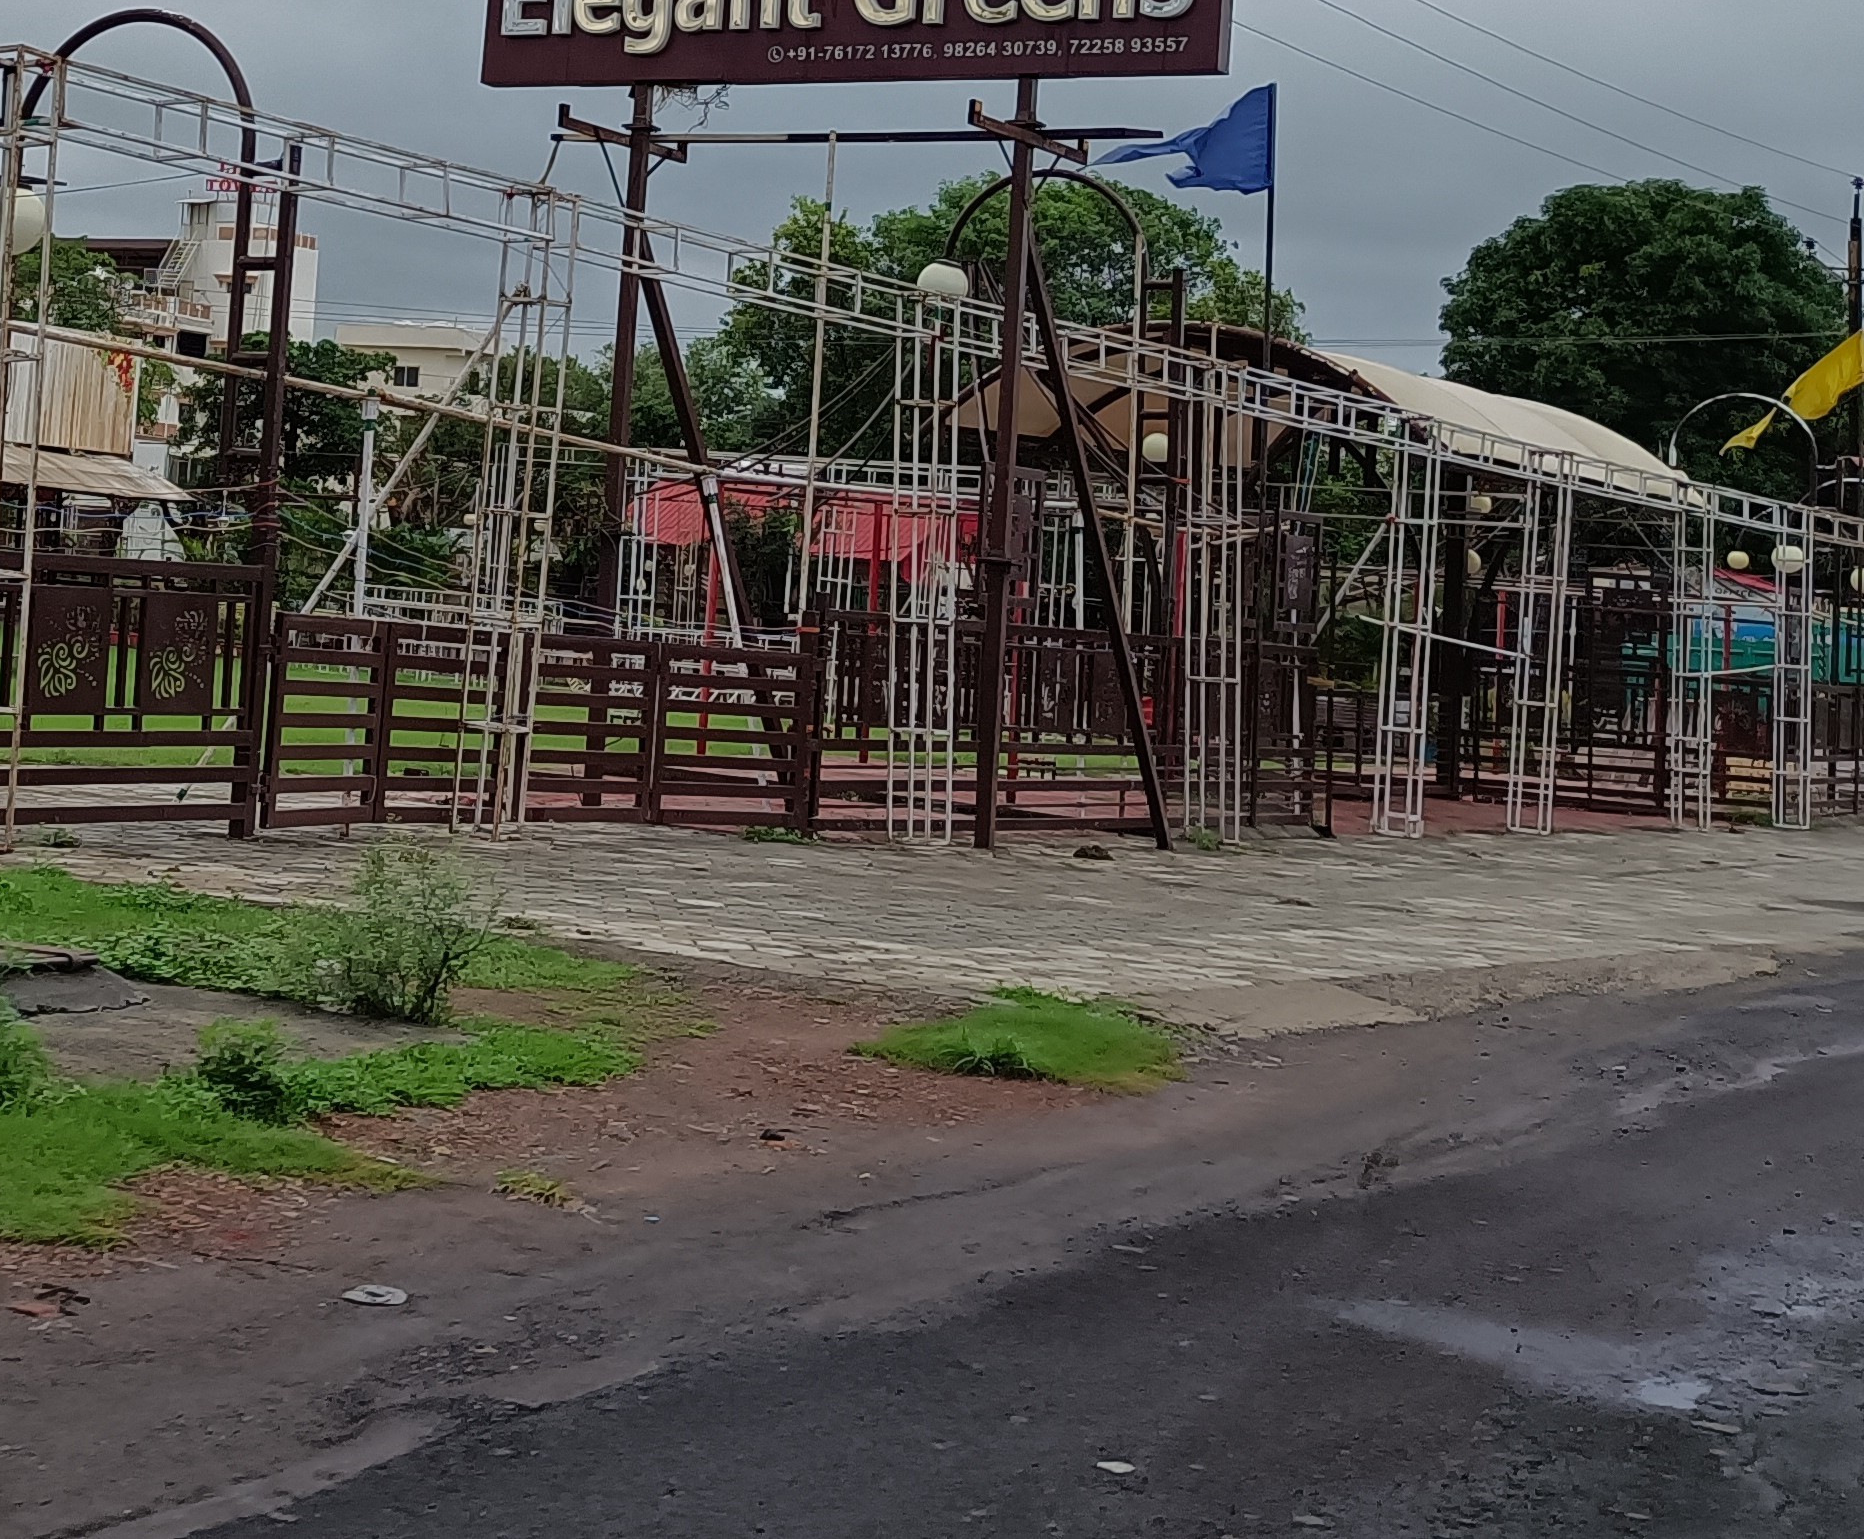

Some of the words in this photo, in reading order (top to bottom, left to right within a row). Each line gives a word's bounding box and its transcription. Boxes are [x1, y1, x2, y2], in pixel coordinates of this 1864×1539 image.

[786, 45, 875, 62] +91-76172
[942, 41, 996, 58] 98264
[1001, 39, 1063, 58] 30739,
[1069, 37, 1124, 55] 72258
[1130, 36, 1189, 53] 93557
